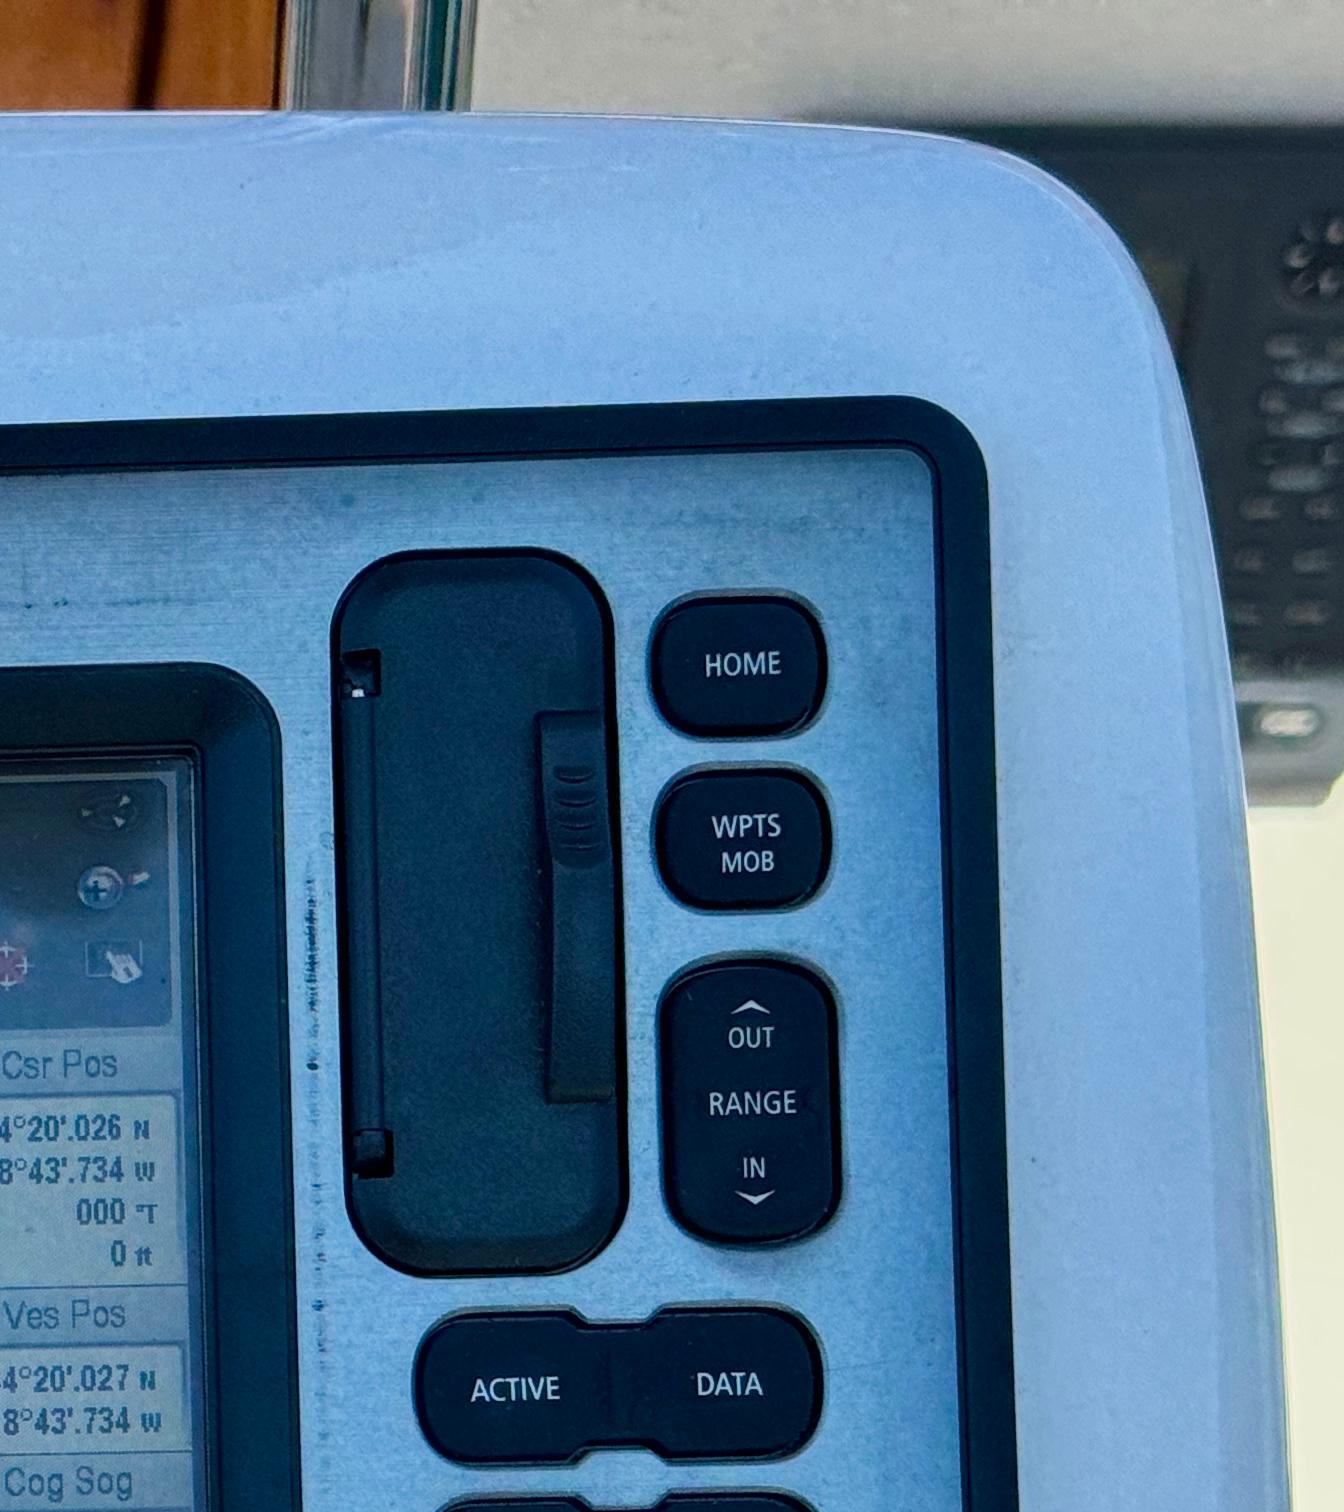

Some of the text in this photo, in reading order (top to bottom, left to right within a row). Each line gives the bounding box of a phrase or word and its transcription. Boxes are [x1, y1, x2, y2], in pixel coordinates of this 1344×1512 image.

[704, 651, 782, 678] HOME
[711, 813, 782, 839] WPTS
[720, 848, 775, 875] MOB
[727, 1025, 775, 1050] OUT
[1, 1049, 118, 1080] Csr Pos
[708, 1090, 797, 1117] RANGE
[133, 1119, 150, 1140] N
[134, 1162, 155, 1182] W
[741, 1155, 766, 1179] IN
[76, 1198, 125, 1226] 000
[111, 1239, 153, 1267] 0 ft
[2, 1299, 126, 1330] Ves Pos
[139, 1369, 156, 1391] N
[470, 1376, 561, 1402] ACTIVE
[696, 1371, 764, 1397] DATA
[141, 1412, 162, 1433] W
[4, 1466, 133, 1502] Cog Sog
